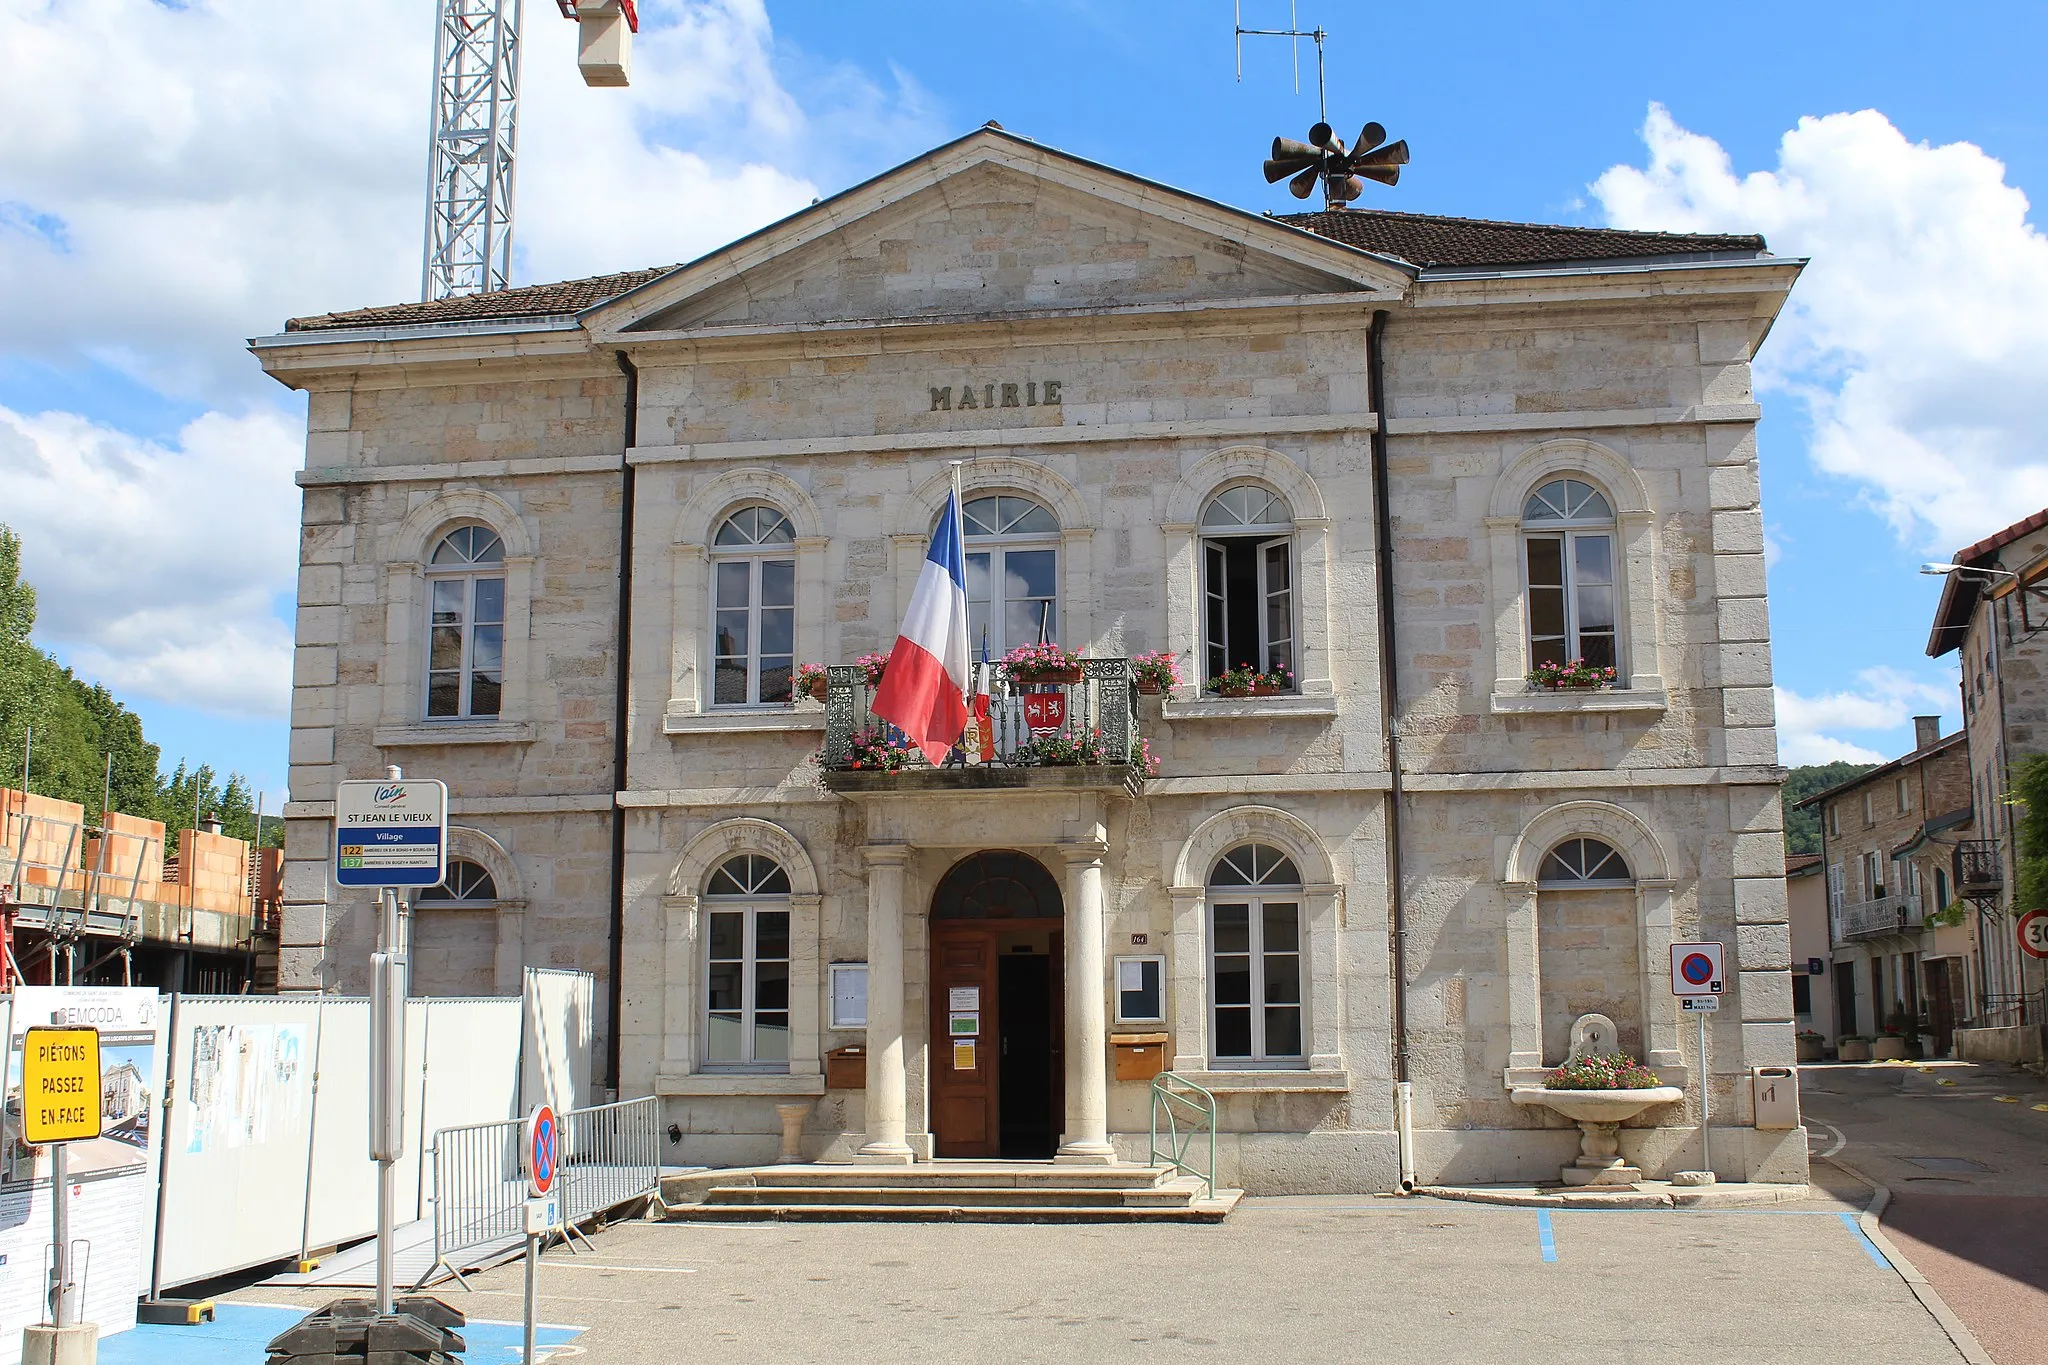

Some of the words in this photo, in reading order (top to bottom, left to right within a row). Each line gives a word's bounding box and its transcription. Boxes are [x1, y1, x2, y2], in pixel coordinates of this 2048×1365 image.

[930, 381, 1062, 411] MAIRIE
[348, 814, 360, 823] ST
[361, 814, 386, 823] JEAN
[389, 813, 400, 822] LE
[403, 813, 432, 822] VIEUX
[376, 833, 404, 842] Village
[343, 846, 361, 855] 122
[344, 858, 361, 867] 137
[59, 1007, 123, 1024] SEMCODA
[39, 1042, 86, 1062] PIÉTONS
[42, 1077, 84, 1094] PASSEZ
[41, 1108, 55, 1126] EN
[60, 1107, 85, 1124] FACE
